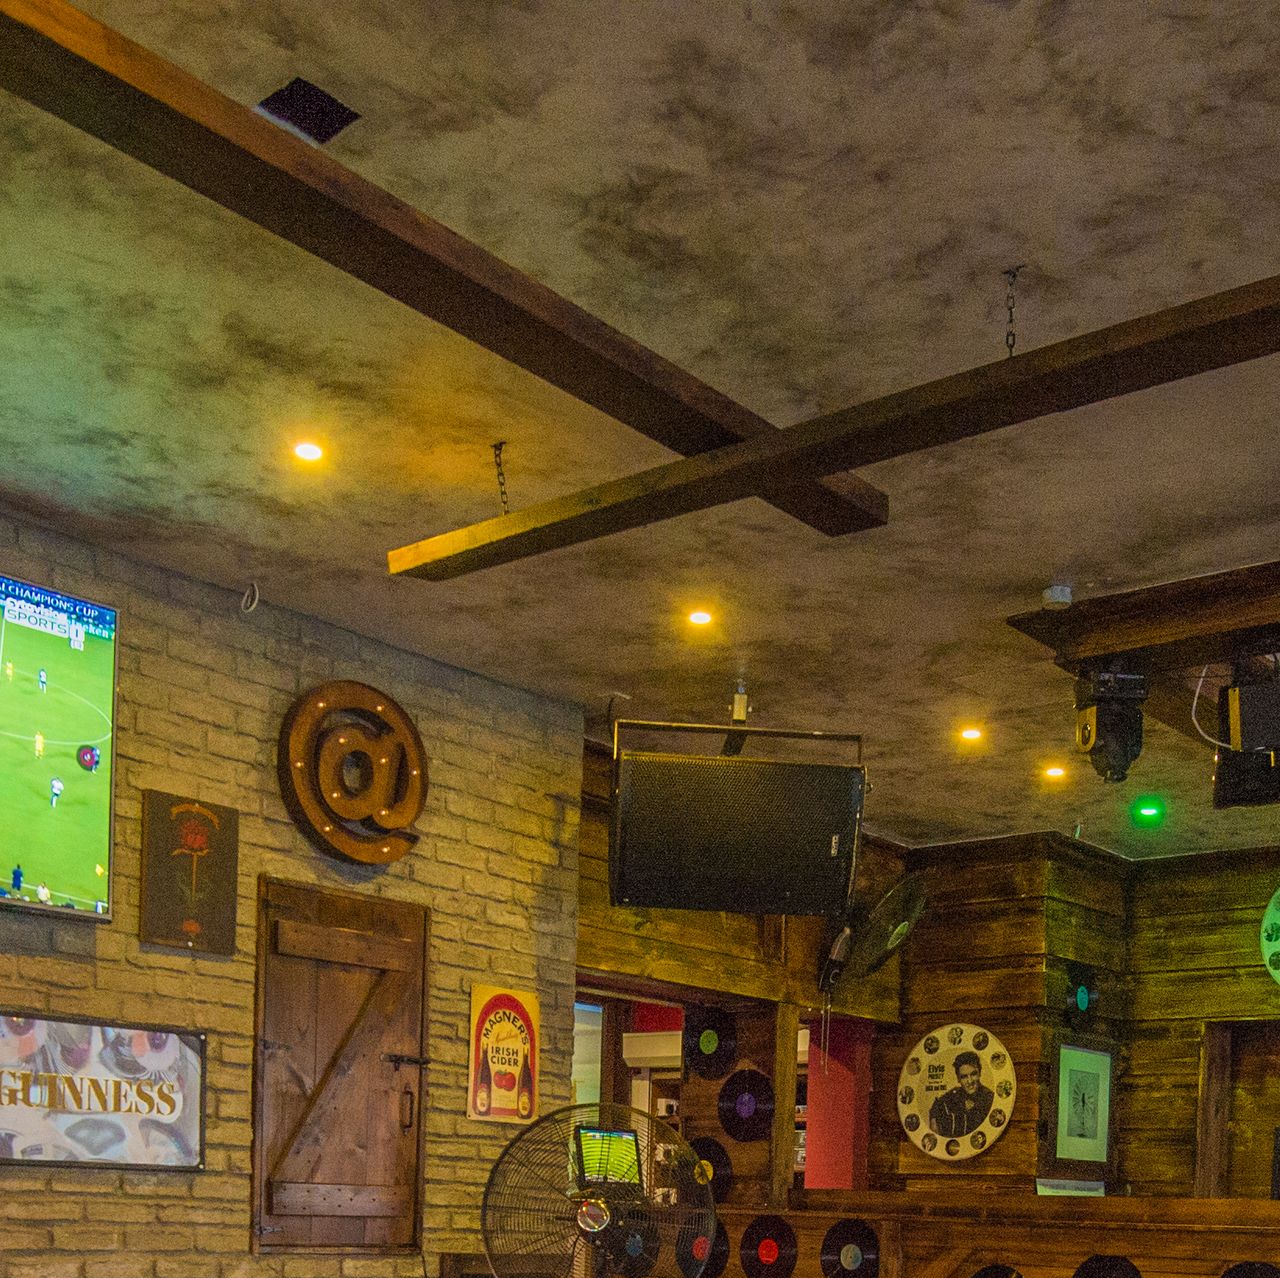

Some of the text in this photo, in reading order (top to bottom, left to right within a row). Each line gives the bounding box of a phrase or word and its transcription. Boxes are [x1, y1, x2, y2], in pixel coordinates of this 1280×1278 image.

[8, 585, 75, 612] CHAMPIONS
[75, 604, 100, 619] CUP
[7, 608, 68, 637] SPORTS
[483, 1010, 529, 1046] MAGNER'S
[490, 1055, 519, 1068] CIDER
[491, 1046, 519, 1058] IRISH
